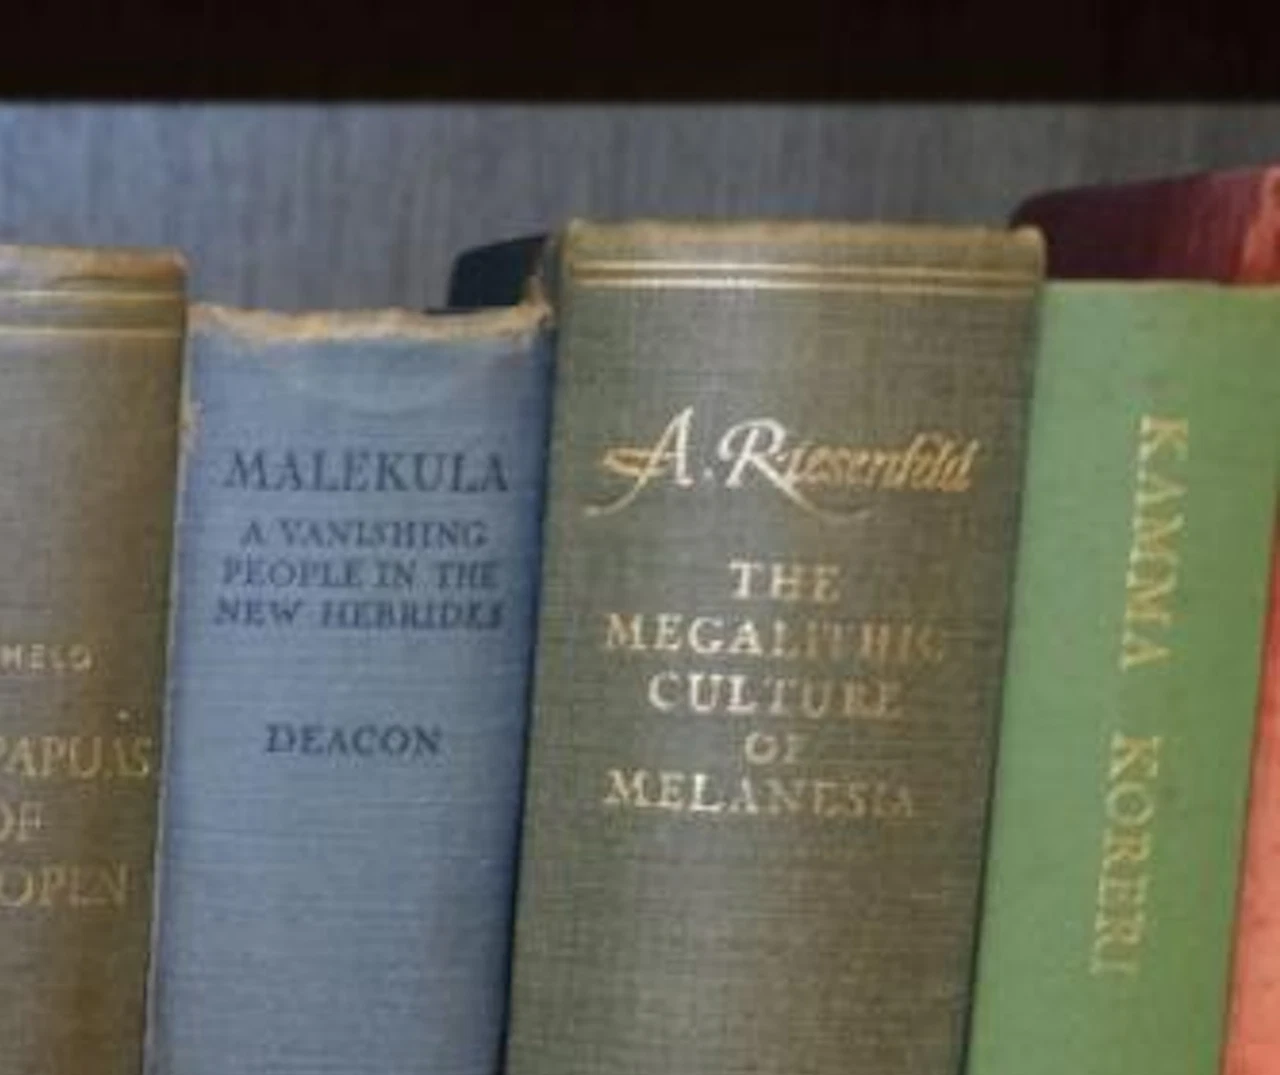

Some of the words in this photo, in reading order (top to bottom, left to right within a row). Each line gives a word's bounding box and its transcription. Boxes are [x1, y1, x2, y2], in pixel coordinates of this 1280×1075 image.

[221, 449, 510, 493] MALEKULA
[240, 519, 268, 548] A
[276, 519, 490, 550] VANISHING
[1120, 414, 1190, 672] KAMMA
[221, 555, 365, 589] PEOPLE
[372, 558, 418, 589] IN
[434, 559, 502, 591] THE
[728, 558, 841, 602] THE
[213, 595, 304, 628] NEW
[321, 600, 506, 631] HEBRIDES
[605, 611, 946, 663] MEGALITHIC
[647, 671, 906, 719] CULTURE
[265, 723, 441, 757] DEACON
[744, 730, 810, 766] OF
[603, 768, 916, 820] MELANESIA
[1089, 730, 1165, 976] KORERI
